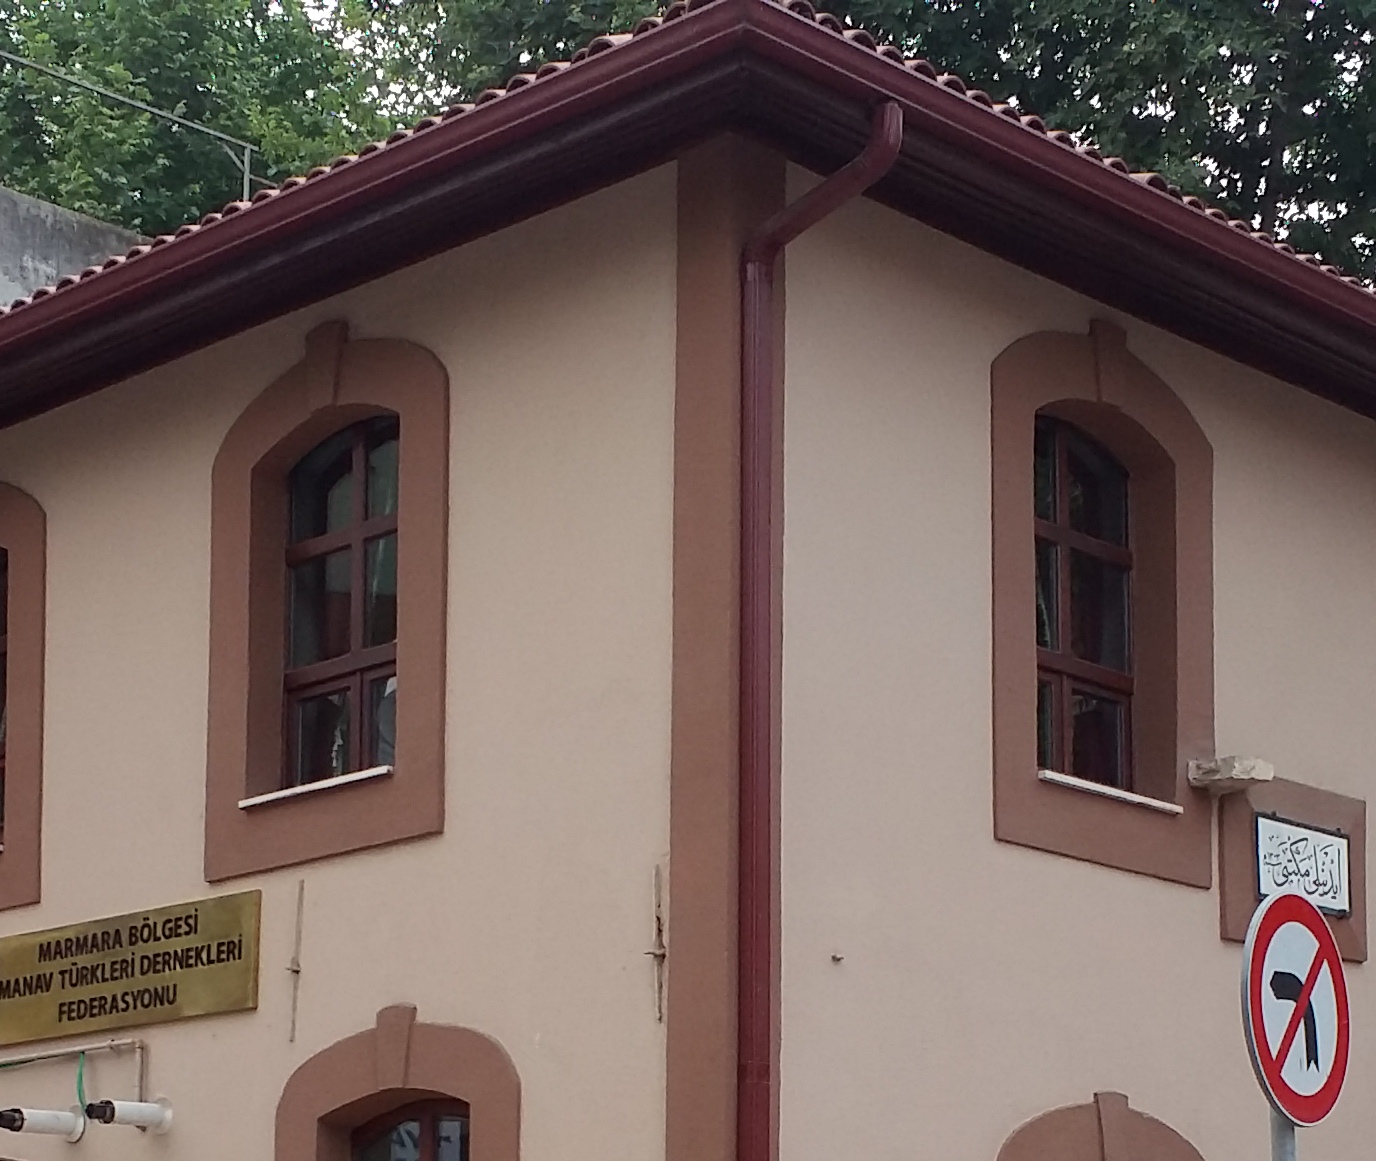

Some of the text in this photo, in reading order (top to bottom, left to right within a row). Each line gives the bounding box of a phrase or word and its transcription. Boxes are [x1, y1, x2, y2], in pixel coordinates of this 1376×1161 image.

[38, 908, 199, 964] MARMARA BÖLGESİ
[58, 951, 136, 990] TÜRKLERİ
[139, 934, 243, 977] DERNEKLERİ
[57, 983, 178, 1023] FEDERASYONU
